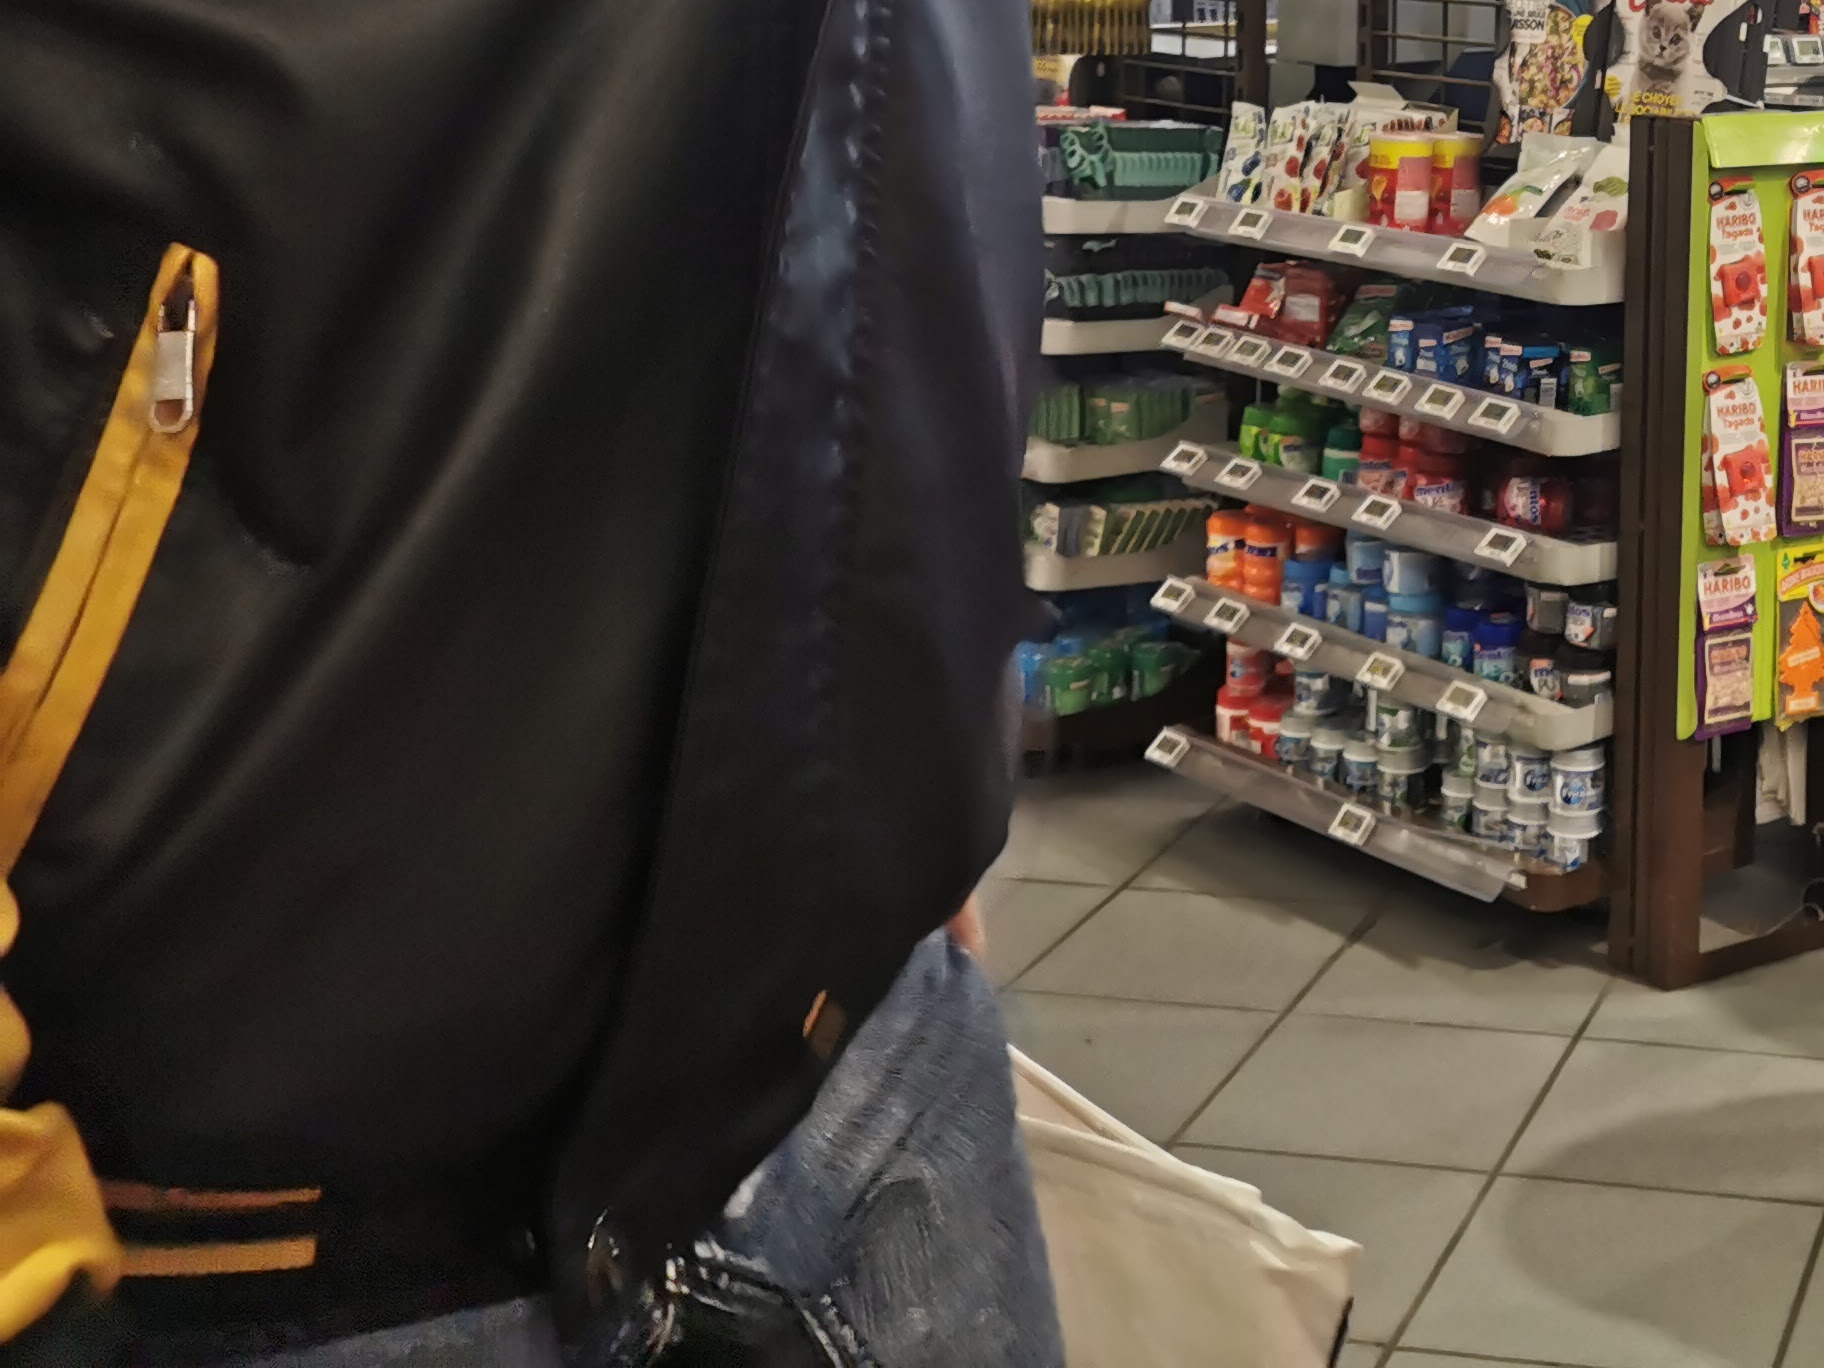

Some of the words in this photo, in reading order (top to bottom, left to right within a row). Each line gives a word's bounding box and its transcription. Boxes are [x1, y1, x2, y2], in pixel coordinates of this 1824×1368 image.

[1717, 212, 1756, 229] HARIBO
[1717, 401, 1756, 418] HARIBO
[1703, 575, 1751, 595] HARIBO
